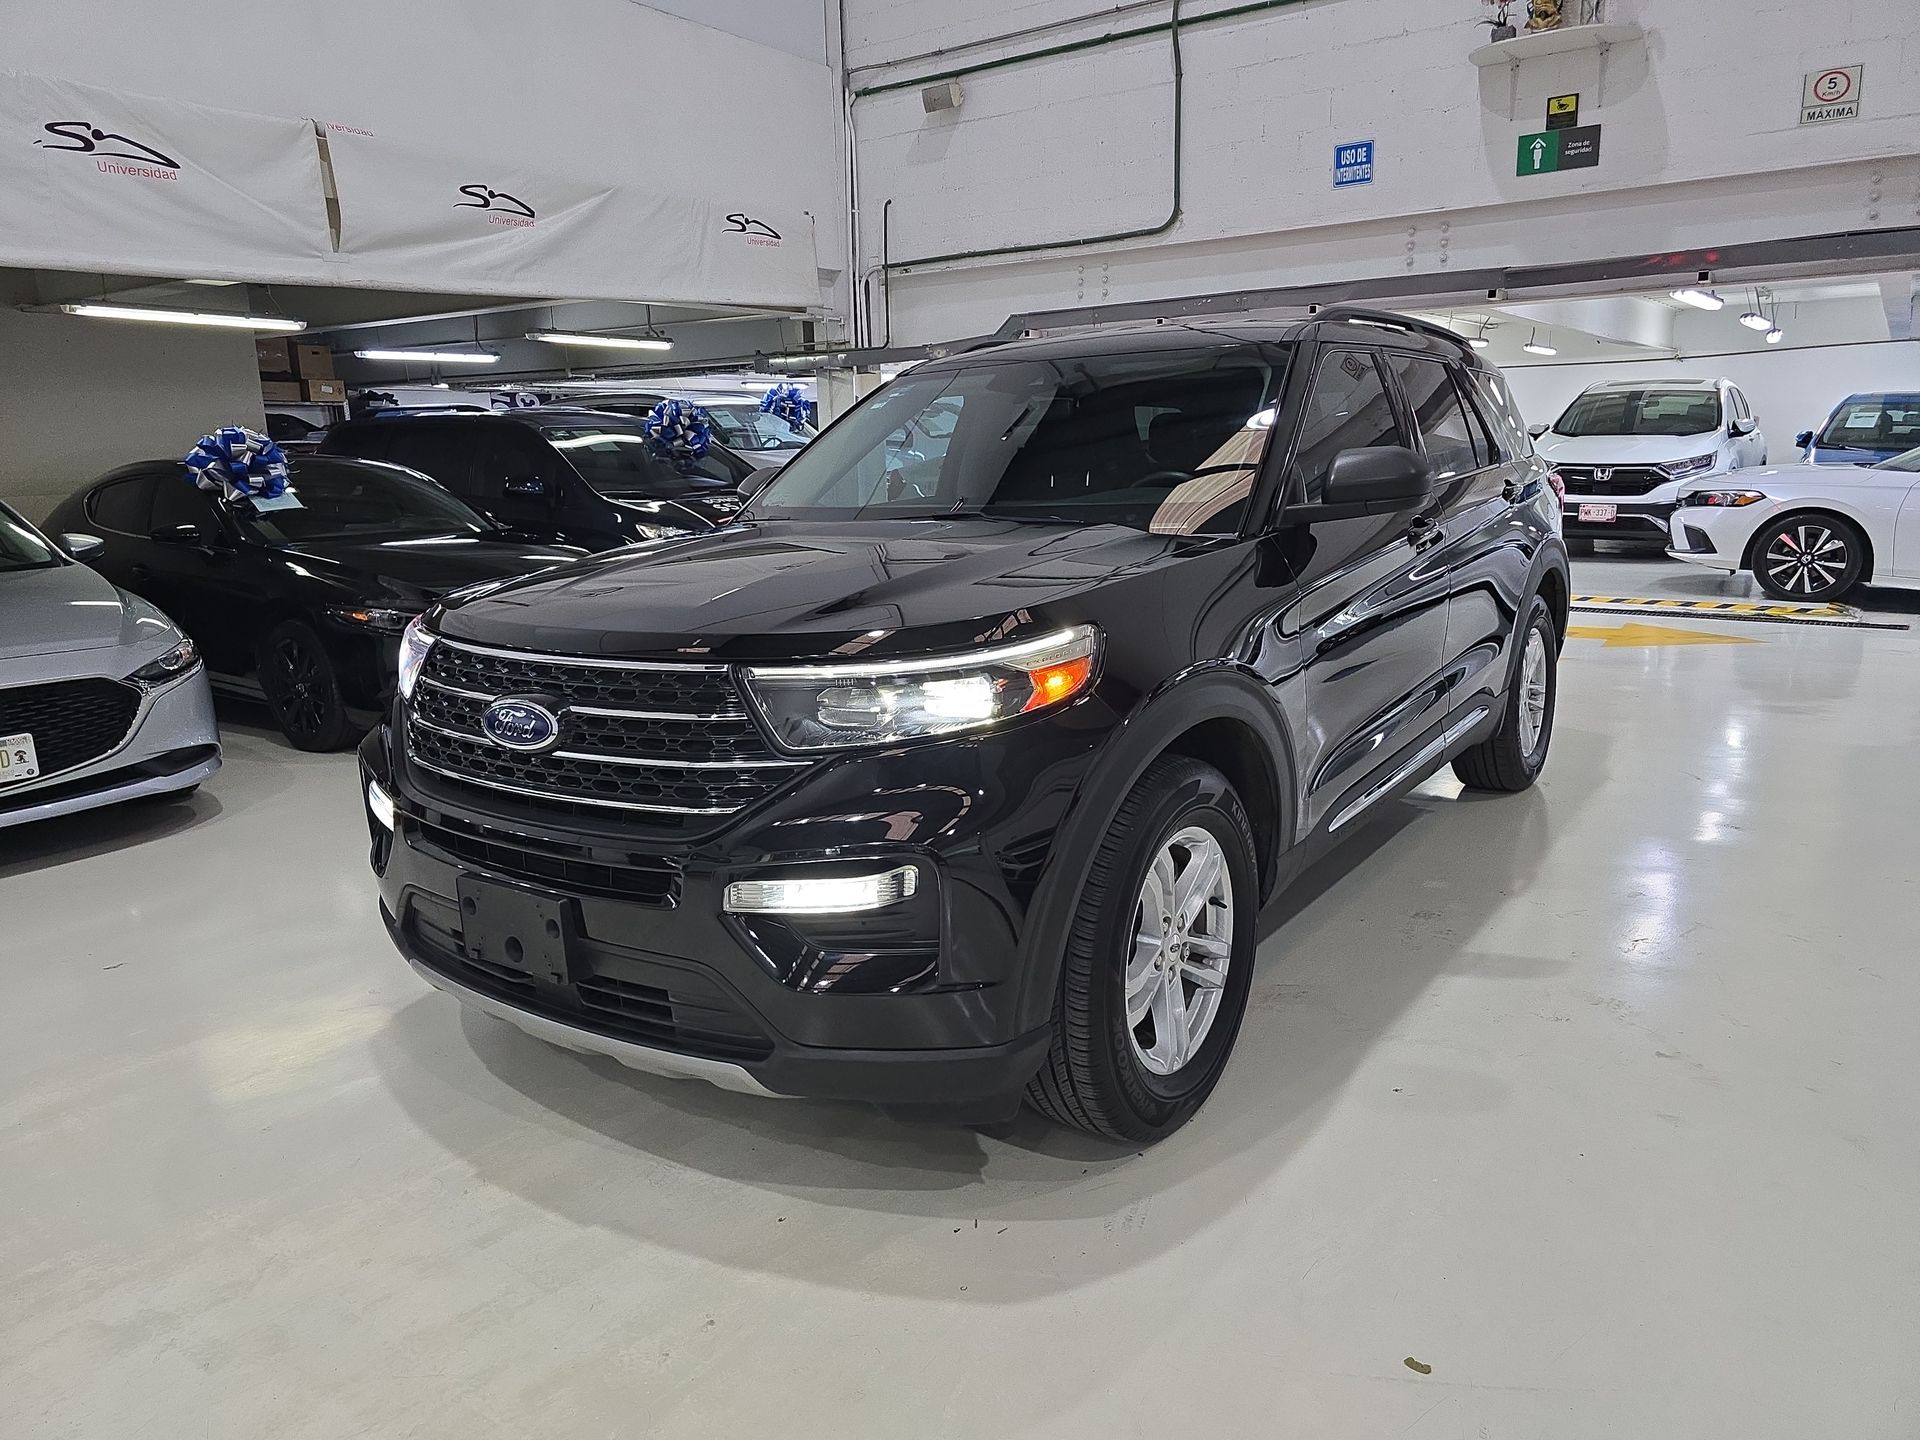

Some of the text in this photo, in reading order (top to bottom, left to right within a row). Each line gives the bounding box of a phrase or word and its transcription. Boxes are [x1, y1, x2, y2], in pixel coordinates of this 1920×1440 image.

[1827, 77, 1838, 90] 5
[1567, 139, 1591, 149] Zona de
[1341, 147, 1367, 166] USO DE
[1564, 146, 1593, 157] seguridad
[96, 160, 178, 181] Universidad
[488, 214, 535, 228] Universidad
[746, 236, 780, 248] Universidad
[494, 708, 537, 738] Ford
